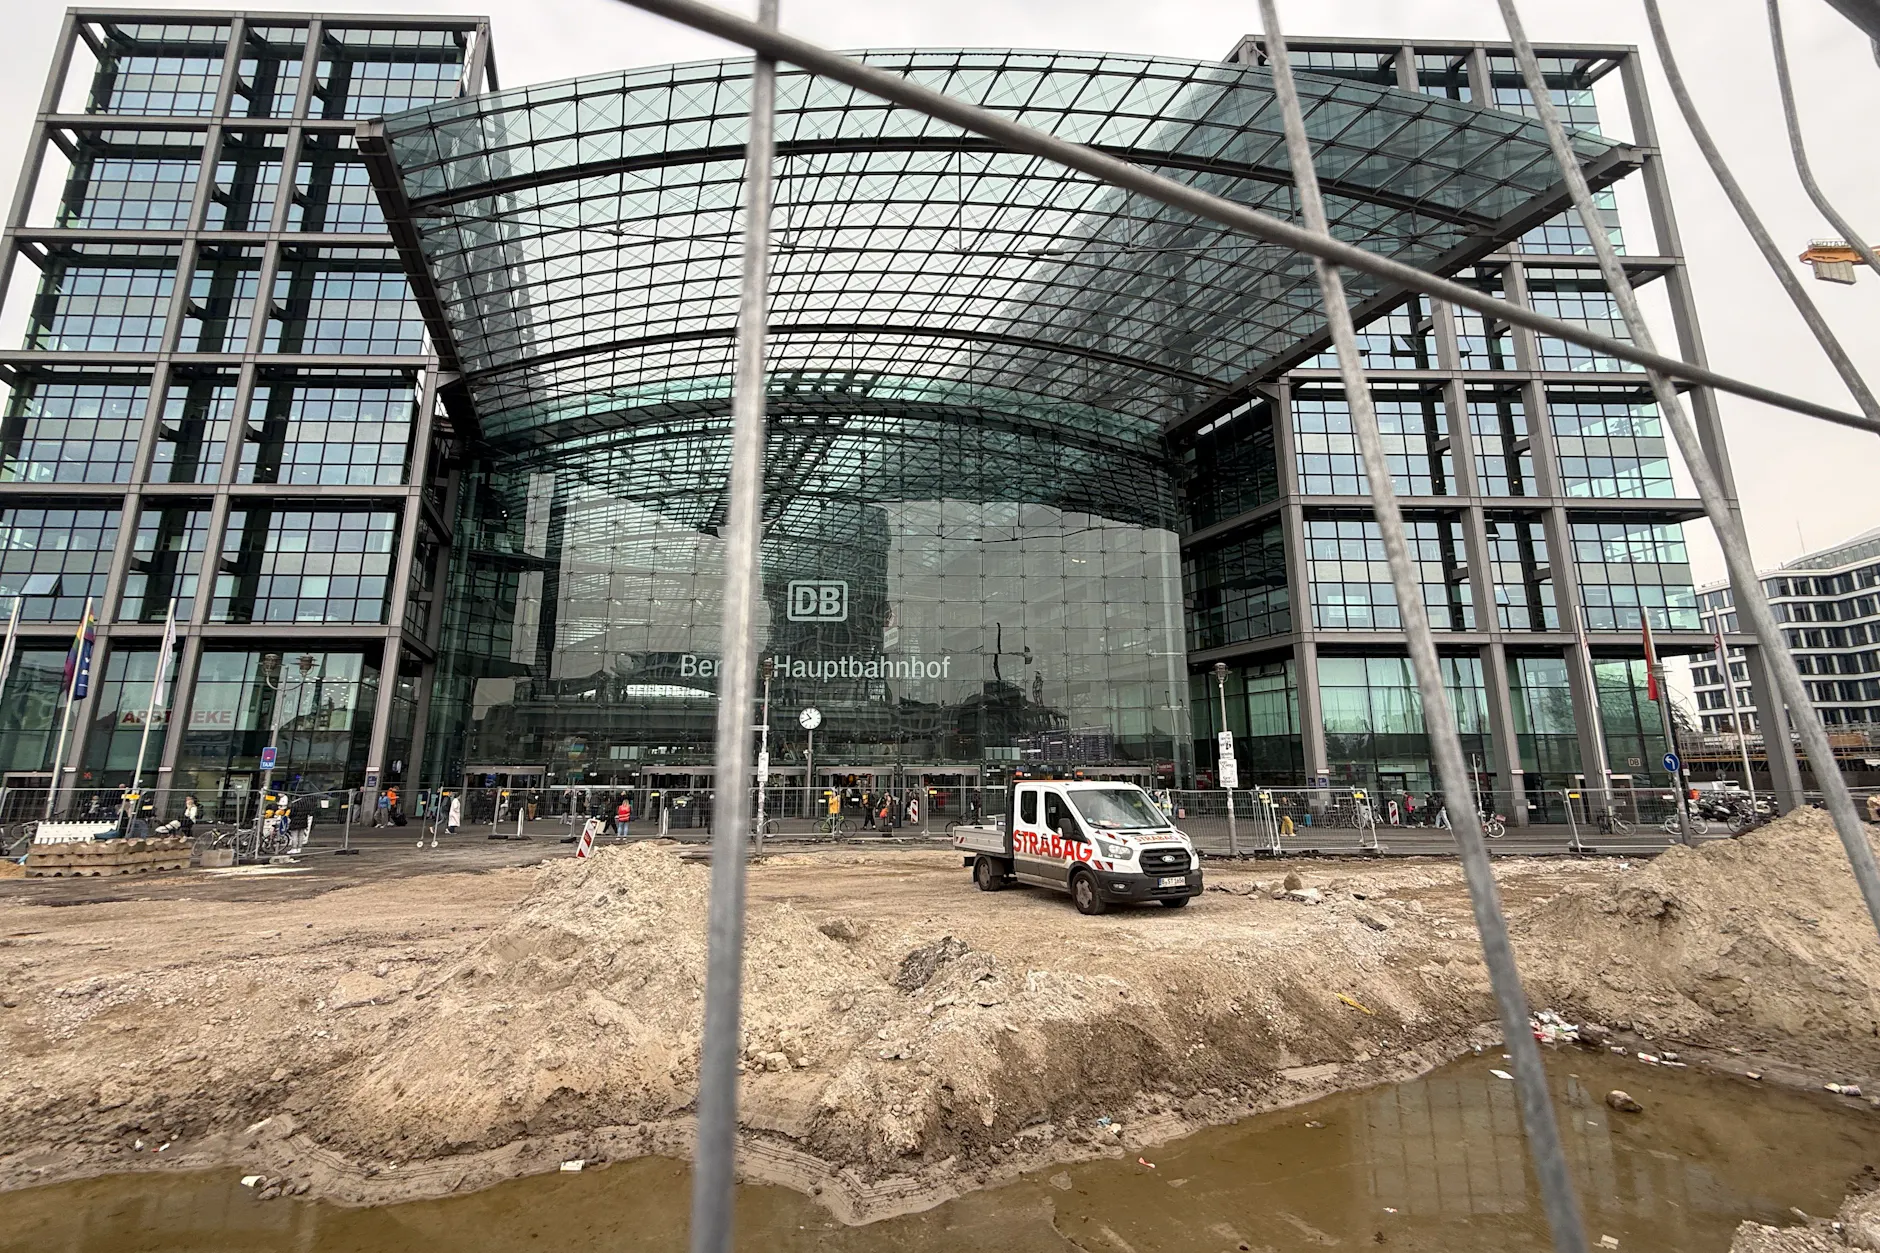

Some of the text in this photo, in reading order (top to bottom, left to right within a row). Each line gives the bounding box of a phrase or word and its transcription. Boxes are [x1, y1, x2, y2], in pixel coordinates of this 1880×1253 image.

[795, 586, 842, 616] DB
[680, 654, 950, 683] Ber Hauptbahnhof
[121, 710, 232, 724] APOTEKE
[1013, 829, 1093, 863] STRABAG
